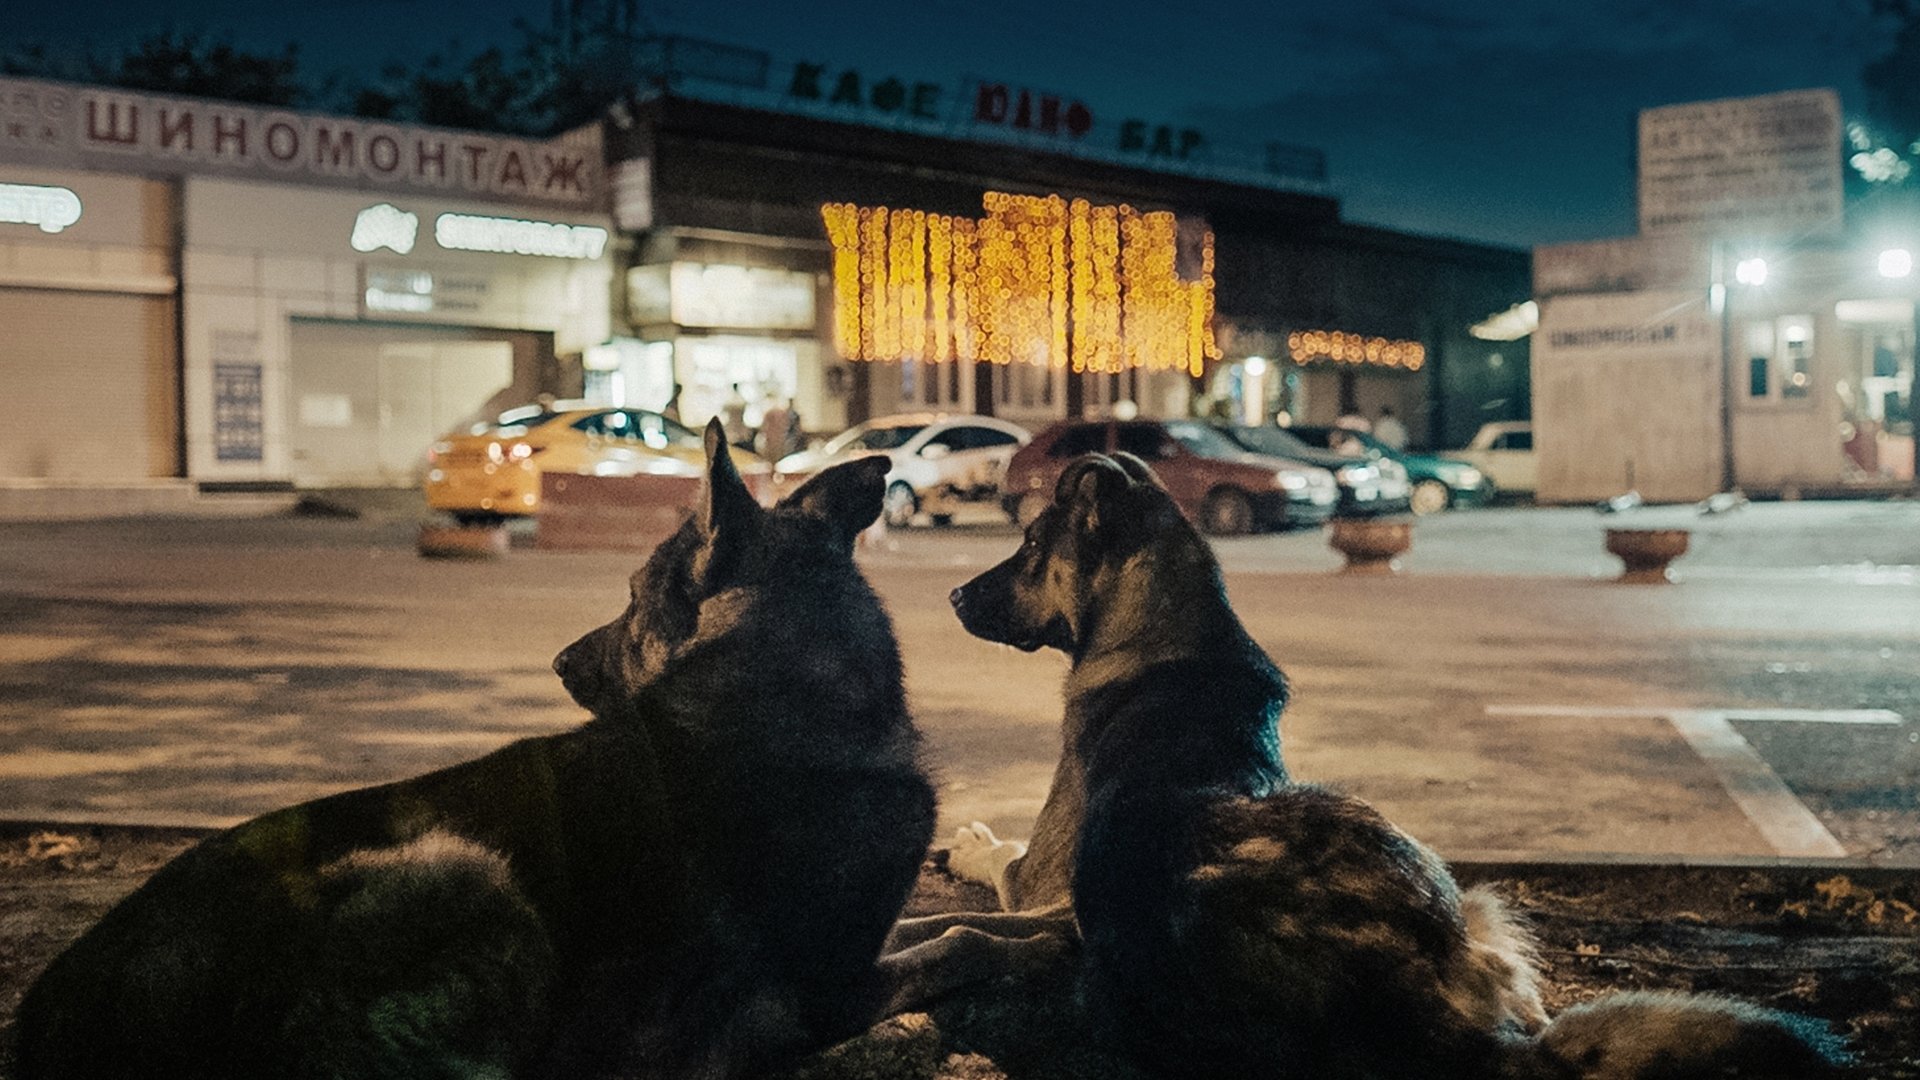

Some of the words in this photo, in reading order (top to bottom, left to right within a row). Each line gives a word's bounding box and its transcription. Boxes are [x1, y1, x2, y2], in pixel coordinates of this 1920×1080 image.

[87, 99, 583, 193] ШИНОМОНТАЖ
[790, 62, 942, 120] КАФЕ
[1118, 119, 1203, 160] БАР
